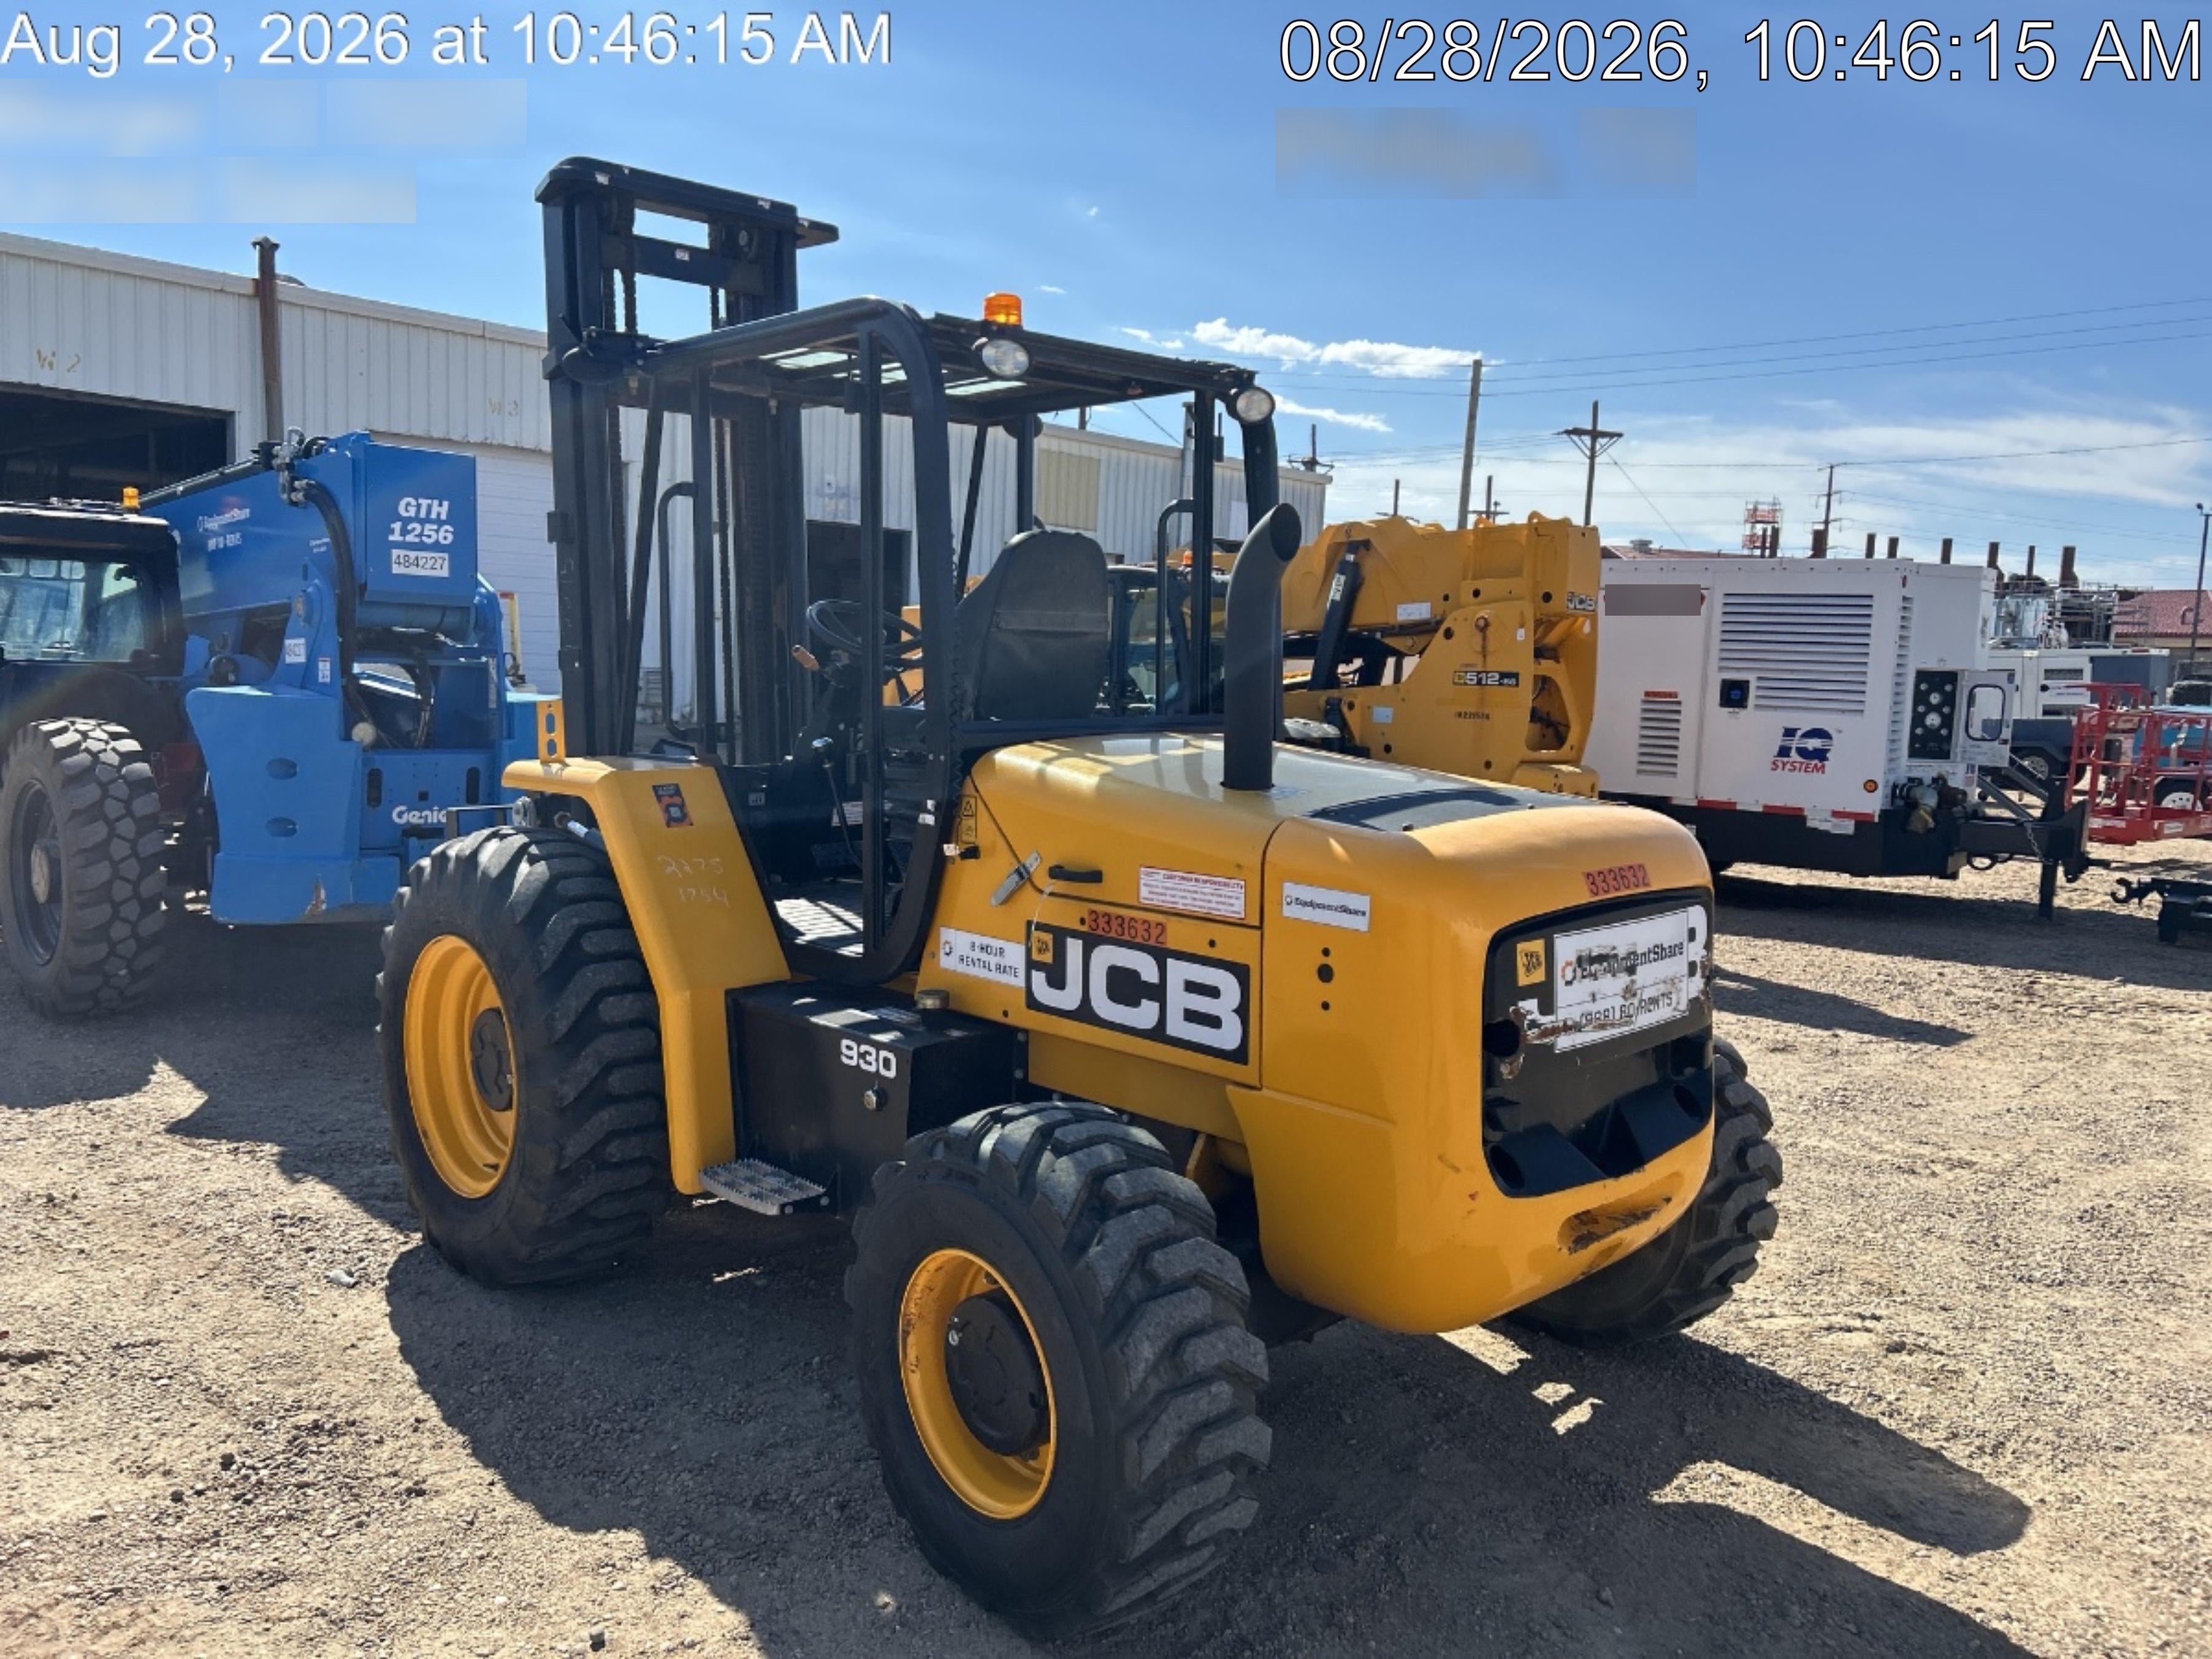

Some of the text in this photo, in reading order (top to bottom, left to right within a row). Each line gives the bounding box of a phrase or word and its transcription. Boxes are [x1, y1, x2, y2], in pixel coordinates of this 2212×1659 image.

[398, 496, 449, 520] GTH
[388, 521, 454, 545] 1256
[394, 554, 447, 571] 484227
[1770, 759, 1826, 775] SYSTEM
[1586, 864, 1650, 896] 333632
[1294, 897, 1367, 917] EquipmentShare
[1088, 910, 1167, 944] 333632
[1031, 937, 1243, 1051] JCB
[840, 1038, 897, 1080] 930
